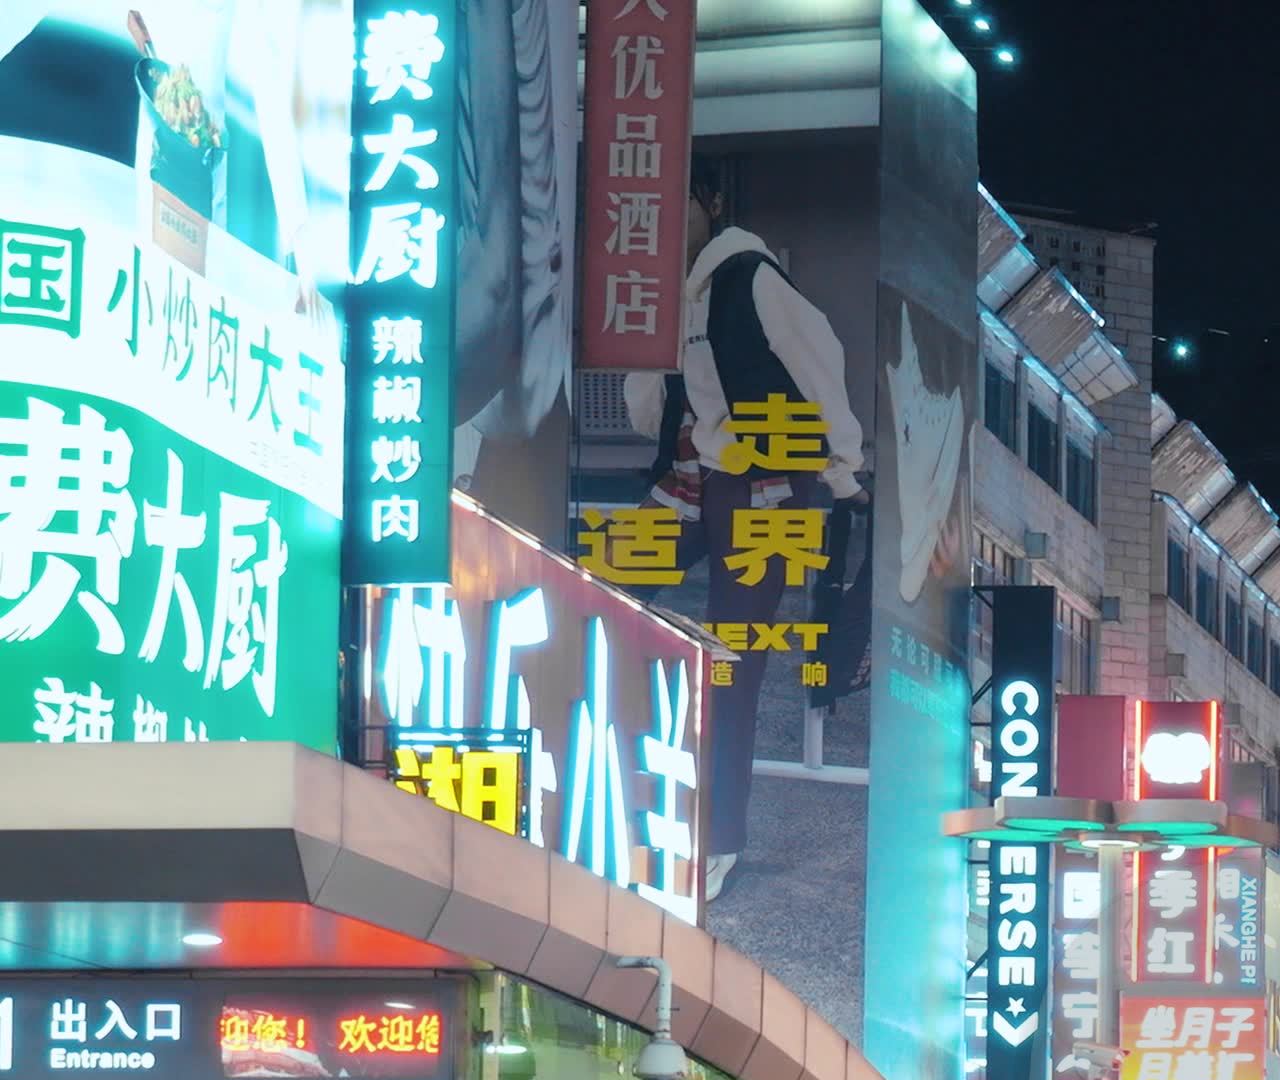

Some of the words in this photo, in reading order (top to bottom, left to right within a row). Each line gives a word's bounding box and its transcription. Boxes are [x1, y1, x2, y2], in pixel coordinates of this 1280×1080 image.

[355, 8, 446, 290] 费大厨
[370, 316, 424, 544] 辣椒炒肉
[719, 393, 831, 475] 走
[0, 392, 290, 717] 费大厨
[998, 680, 1040, 986] CONERSE
[49, 1047, 155, 1070] Entrance
[50, 999, 181, 1041] 出入口
